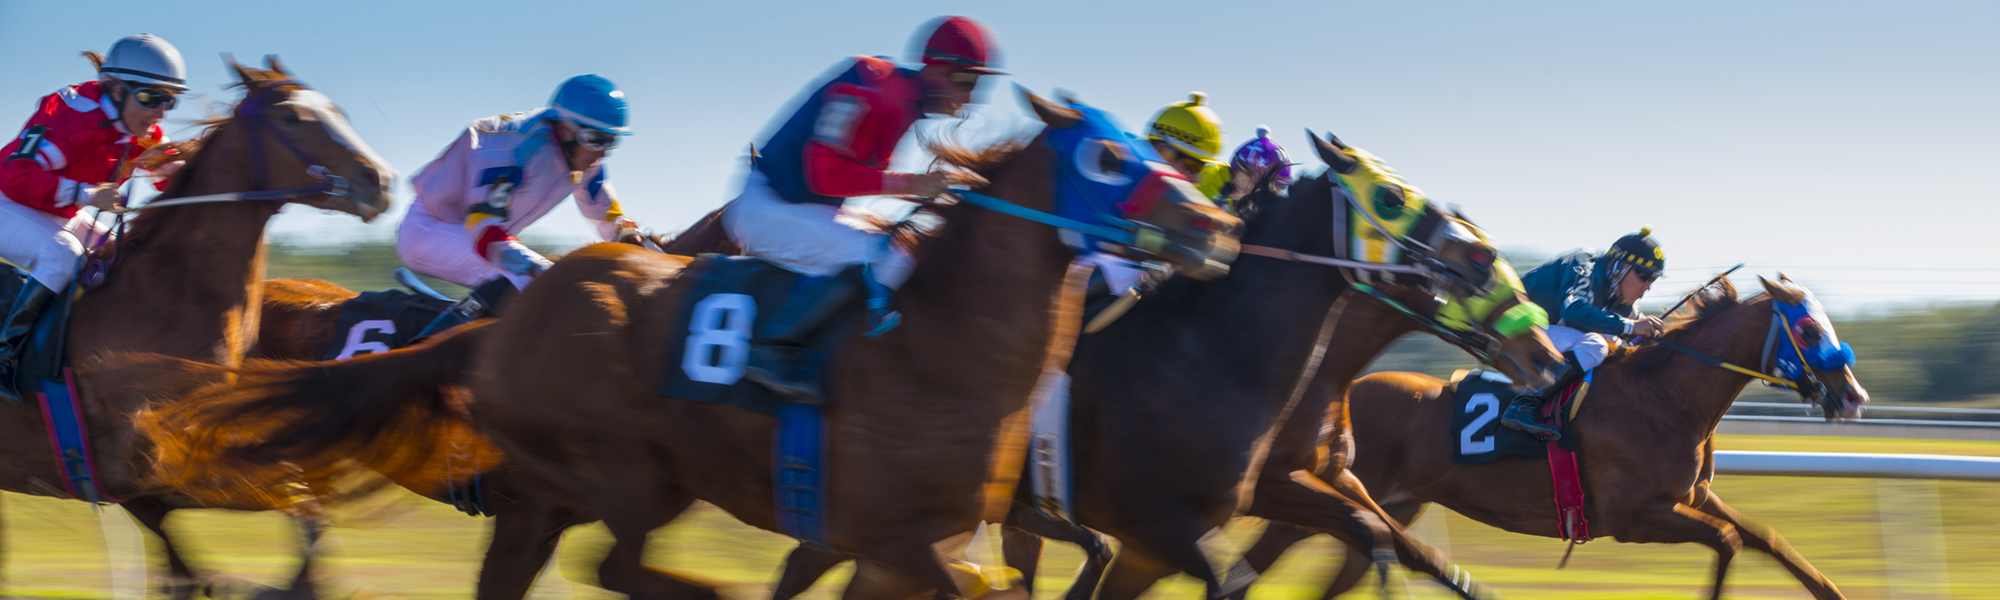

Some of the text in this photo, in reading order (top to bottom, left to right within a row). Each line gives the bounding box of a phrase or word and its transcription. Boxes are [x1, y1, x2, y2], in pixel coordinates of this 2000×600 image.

[487, 182, 515, 209] 6
[1573, 277, 1591, 296] 2
[335, 319, 397, 362] 6
[681, 293, 759, 386] 8
[1461, 393, 1500, 455] 2
